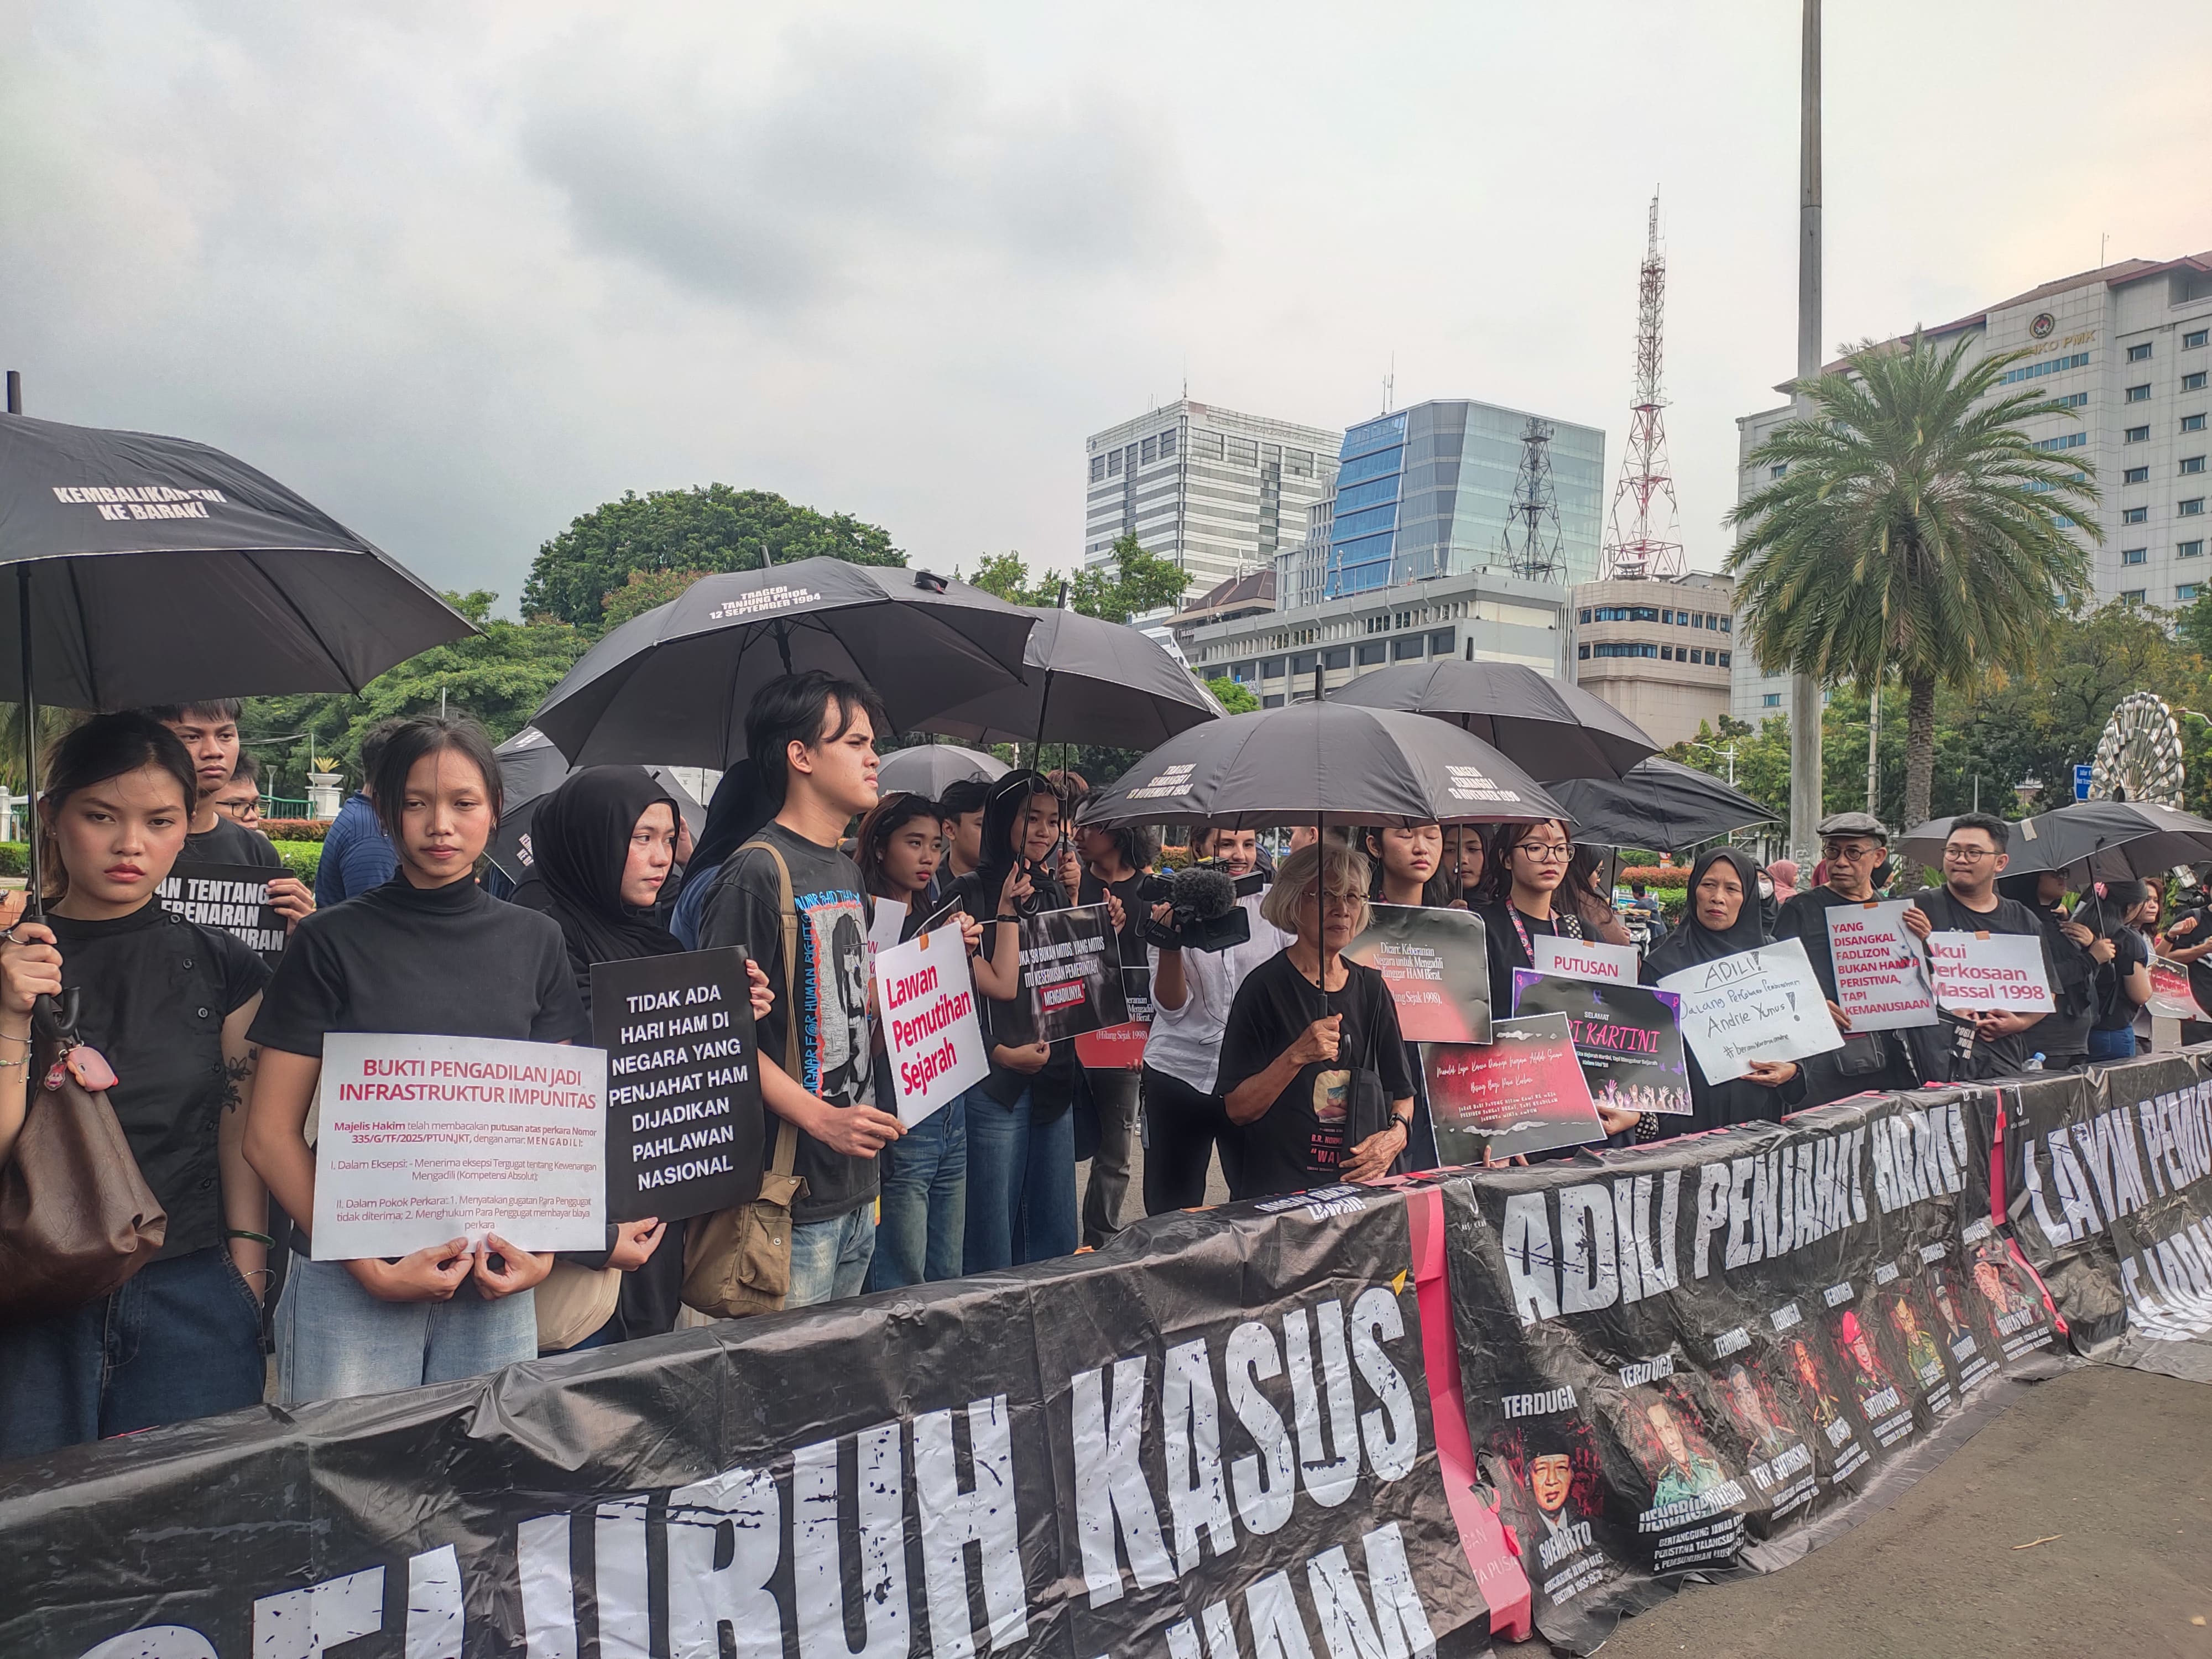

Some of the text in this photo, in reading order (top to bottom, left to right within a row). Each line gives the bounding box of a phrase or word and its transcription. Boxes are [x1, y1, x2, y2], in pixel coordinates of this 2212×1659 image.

[2063, 330, 2096, 348] PMK
[97, 502, 210, 520] KE BARAK!
[721, 588, 808, 610] TANJUNG PRIOK
[740, 586, 787, 600] TRAGEDI
[725, 599, 790, 617] SEPTEMBER
[792, 593, 821, 605] 1984
[188, 879, 270, 905] TENTANG
[1832, 922, 1864, 934] YANG
[1039, 945, 1056, 962] BUKAN
[1073, 940, 1088, 955] YANG
[1088, 936, 1105, 953] MITOS
[1380, 942, 1434, 957] Dicari: Keberanian
[1834, 933, 1897, 948] DISANGKAL
[1373, 954, 1443, 969] Negara untuk Mengadili
[1836, 947, 1890, 961] FADLIZON
[1024, 959, 1098, 988] ITU KESERIUSAN PEMERINTAH
[1406, 968, 1424, 980] HAM
[1553, 956, 1619, 977] PUTUSAN
[1705, 951, 1762, 988] ADILI!
[1838, 958, 1921, 975] BUKAN HANYA
[886, 964, 938, 1011] Lawan
[1839, 974, 1901, 988] PERISTIWA,
[627, 985, 721, 1014] TIDAK ADA
[1406, 991, 1442, 1006] Sejak 1998).
[1841, 990, 1867, 1003] TAPI
[1999, 985, 2046, 1000] 1998
[1584, 1011, 1609, 1021] SELAMAT
[1845, 998, 1929, 1016] KEMANUSIAAN
[621, 1012, 729, 1045] HARI HAM DI
[892, 991, 972, 1053] Pemutihan
[1117, 1030, 1131, 1041] Sejak
[1585, 1022, 1661, 1053] KARTINI
[612, 1039, 740, 1076] NEGARA YANG
[901, 1037, 957, 1097] Sejarah
[363, 1059, 581, 1087] BUKTI PENGADILAN JADI
[339, 1083, 596, 1110] INFRASTRUKTUR IMPUNITAS
[609, 1066, 748, 1107] PENJAHAT HAM
[632, 1098, 730, 1132] DIJADIKAN
[335, 1122, 370, 1133] Majelis
[372, 1121, 405, 1131] Hakim
[407, 1122, 430, 1130] telah
[431, 1122, 489, 1131] membacakan
[491, 1124, 523, 1135] putusan
[542, 1126, 571, 1137] perkara
[572, 1128, 597, 1137] Nomor
[473, 1135, 503, 1146] dengan
[633, 1125, 734, 1162] PAHLAWAN
[338, 1159, 597, 1172] Dalam Eksepsi: Menerima eksepsi Tergugat tentang Kewenangan
[638, 1155, 733, 1191] NASIONAL
[412, 1171, 455, 1183] Mengadili
[457, 1170, 507, 1182] (Kompetensi
[346, 1199, 377, 1208] Dalam
[379, 1198, 408, 1207] Pokok
[459, 1196, 508, 1207] Menyatakan
[509, 1197, 538, 1207] gugatan
[539, 1197, 554, 1205] Para
[556, 1197, 591, 1208] Penggugat
[337, 1212, 360, 1222] tidak
[416, 1209, 473, 1219] Menghukum
[476, 1208, 493, 1217] Para
[494, 1208, 533, 1219] Penggugat
[534, 1209, 571, 1219] membayar
[572, 1209, 590, 1219] biaya
[465, 1220, 495, 1230] perkara
[1503, 1170, 1682, 1327] ADILI
[1694, 1125, 1867, 1279] PENJAHAT
[1713, 1327, 1752, 1359] TERDUGA
[1618, 1355, 1674, 1388] TERDUGA
[1501, 1385, 1578, 1418] TERDUGA
[1071, 1287, 1418, 1609] KASUS
[1749, 1462, 1775, 1490] TRY
[1771, 1443, 1811, 1480] SUTRISNO
[1659, 1527, 1709, 1547] BERTANGGUNG
[1711, 1520, 1733, 1535] JAWAB
[1539, 1521, 1592, 1570] SOEHARTO
[1654, 1545, 1694, 1559] PERISTIWA
[1589, 1552, 1604, 1567] ATAS
[1661, 1551, 1712, 1569] PEMBUNUHAN
